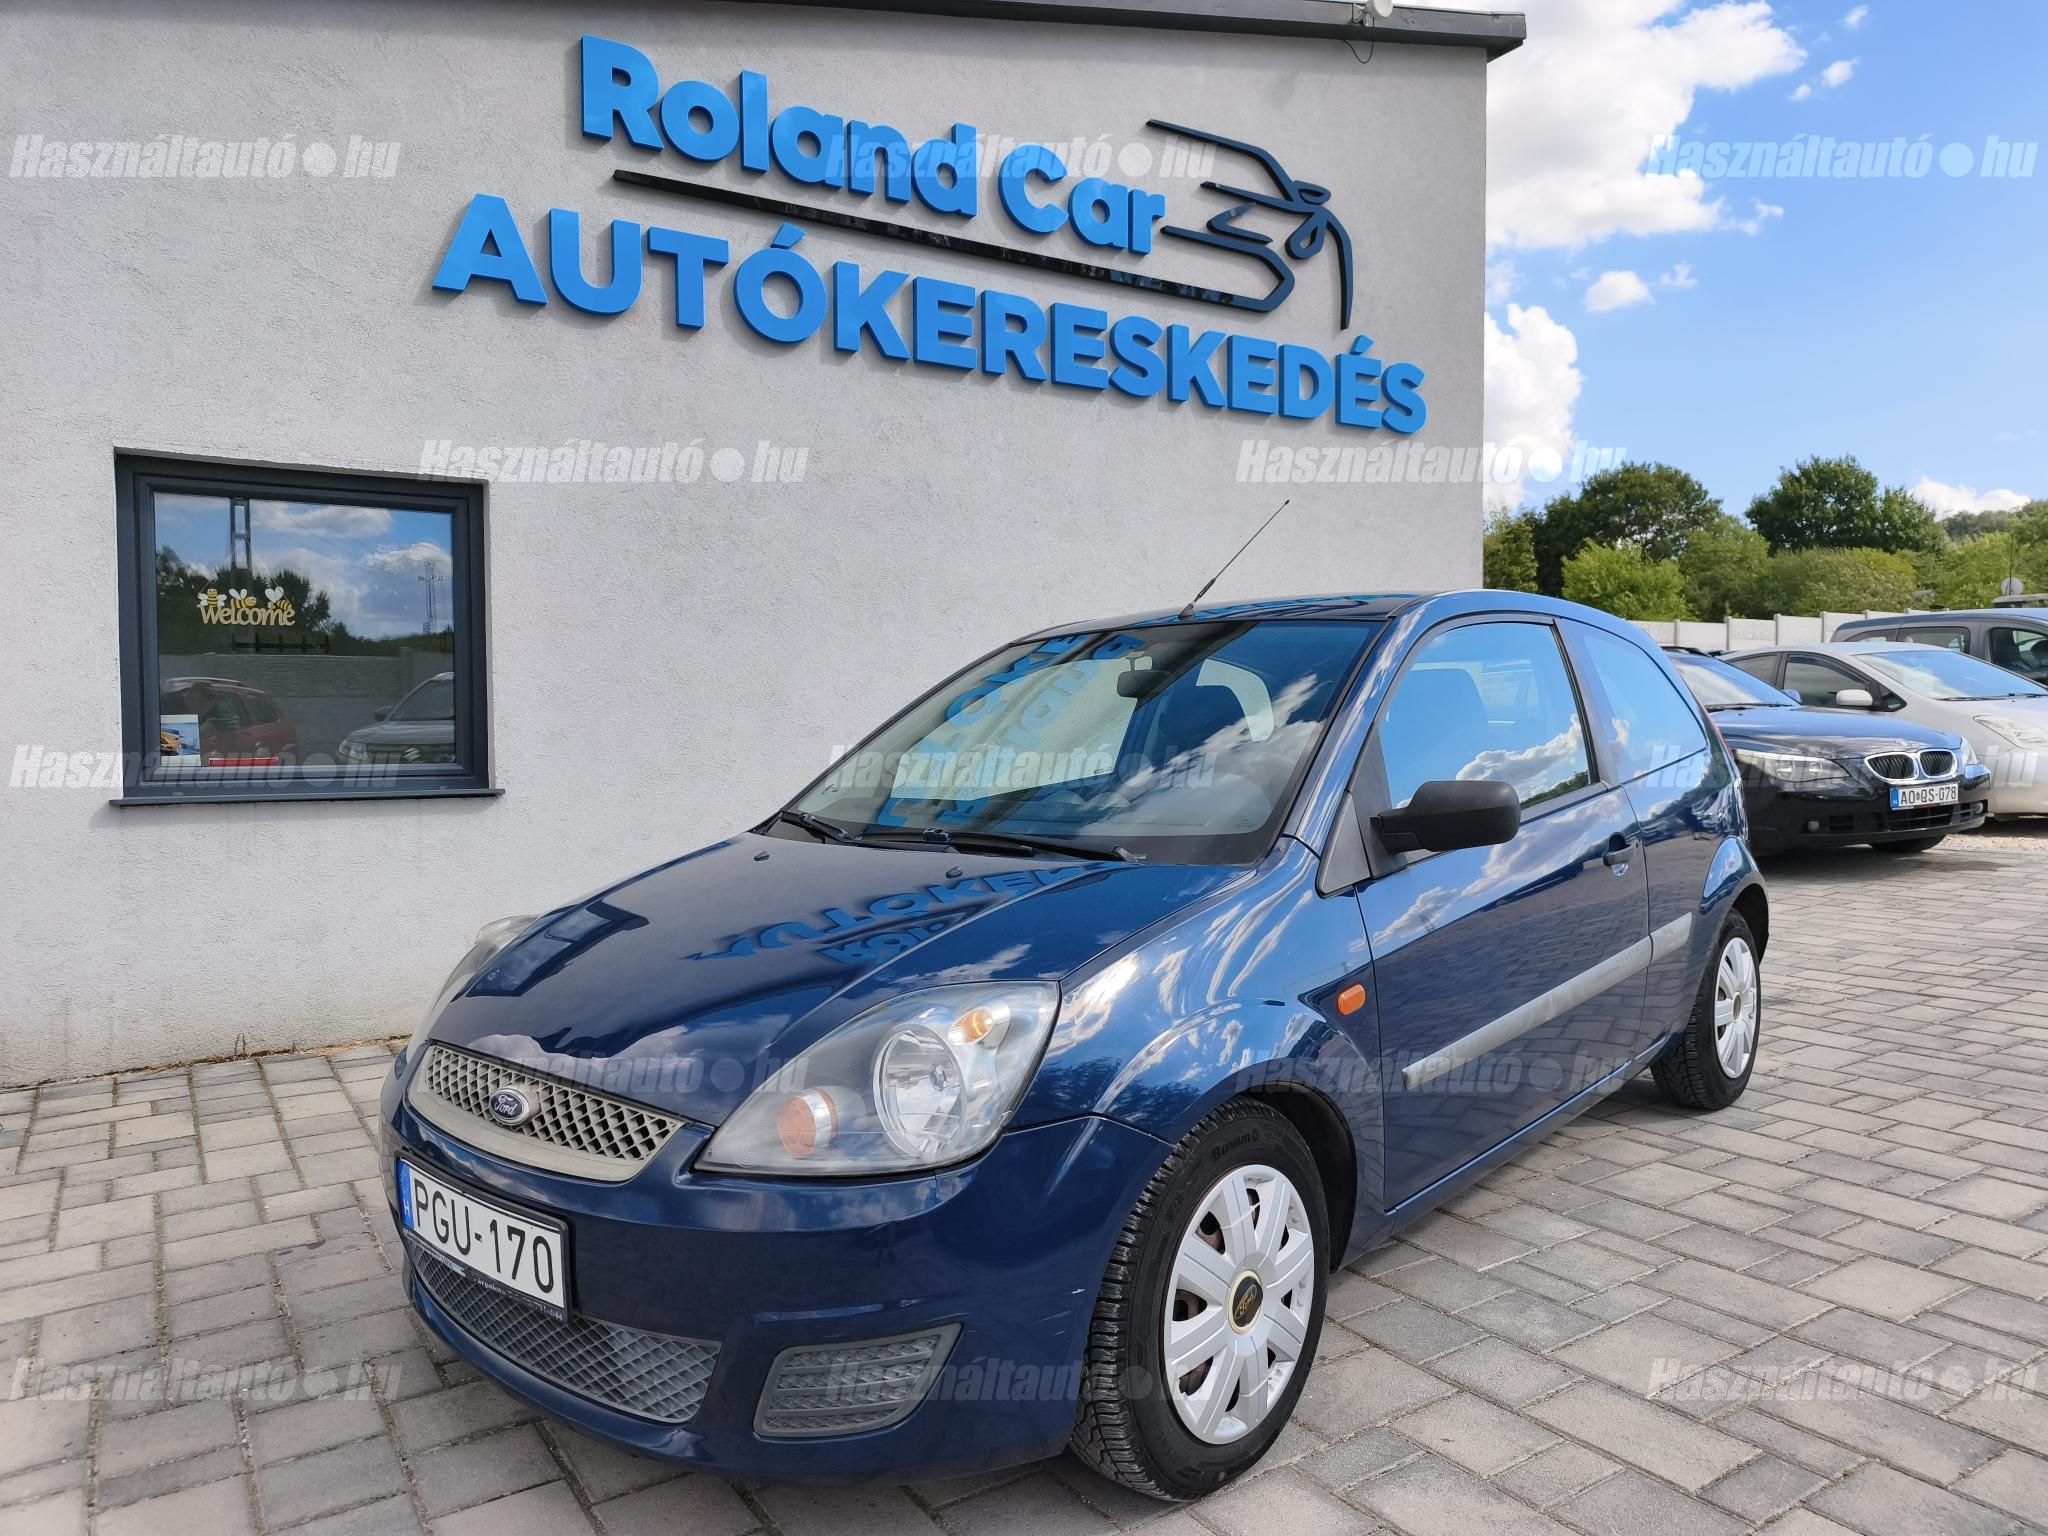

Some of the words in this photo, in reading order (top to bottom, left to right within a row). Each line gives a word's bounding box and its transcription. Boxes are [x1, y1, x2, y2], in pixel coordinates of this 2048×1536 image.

[580, 34, 977, 217] Roland
[998, 143, 1165, 255] Car
[432, 193, 1428, 434] AUTÓKERESKEDÉS
[494, 1094, 518, 1116] Ford
[413, 1178, 555, 1294] PGU-170
